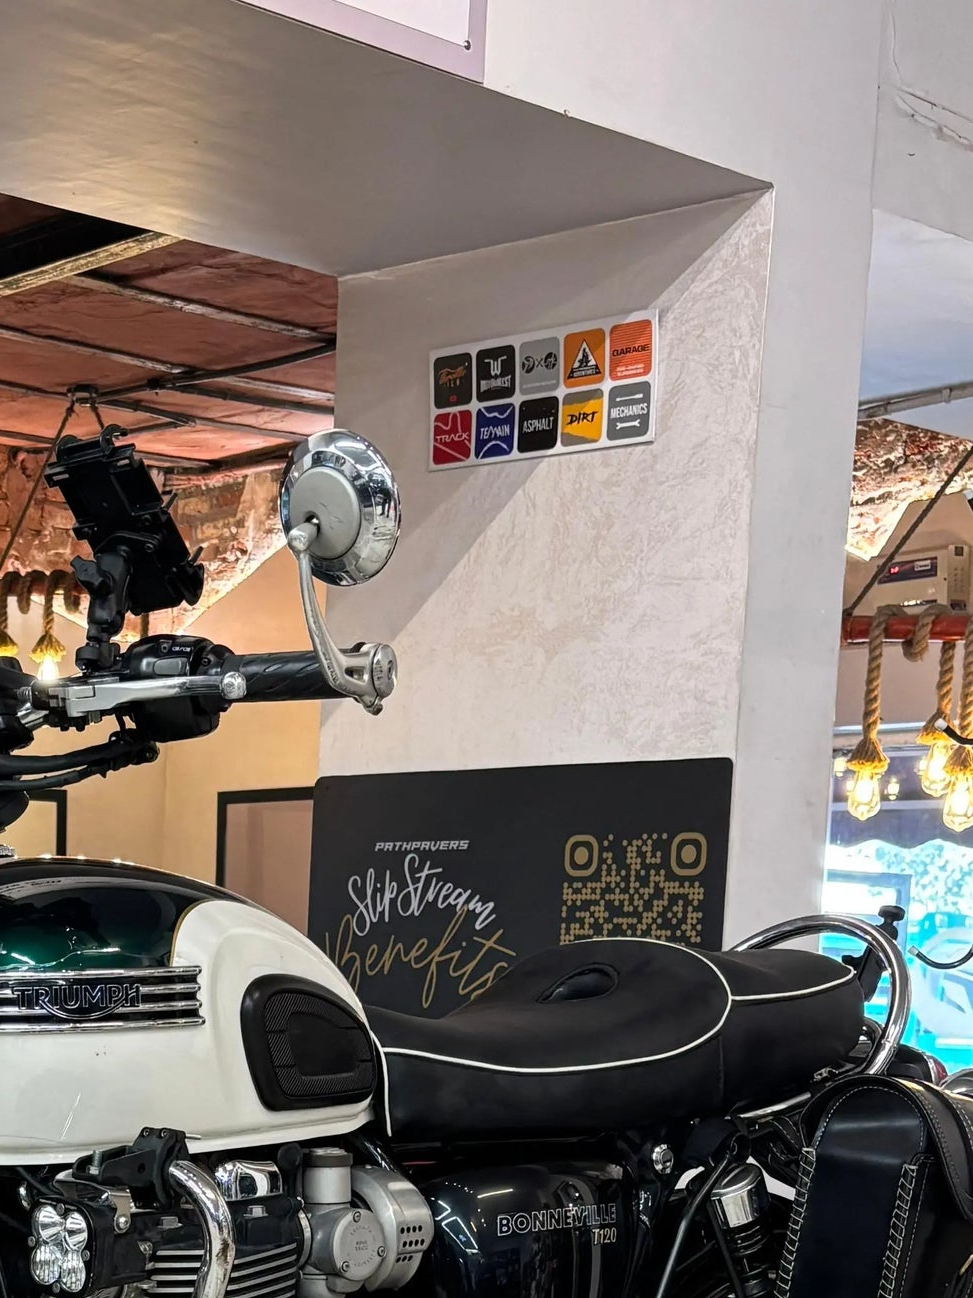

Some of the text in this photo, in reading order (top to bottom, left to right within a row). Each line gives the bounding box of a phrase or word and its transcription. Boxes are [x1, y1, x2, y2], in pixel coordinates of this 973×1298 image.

[612, 343, 650, 358] GARAGE
[566, 410, 599, 426] DIRT
[610, 402, 648, 419] MECHANICS
[522, 416, 554, 433] ASPHALT
[435, 431, 470, 444] TRACK
[374, 840, 470, 852] PATHPAVERS
[326, 904, 516, 1008] Benefits
[11, 983, 142, 1017] TRIUMPH
[496, 1203, 617, 1237] BONNEVILLE
[592, 1227, 617, 1246] T120
